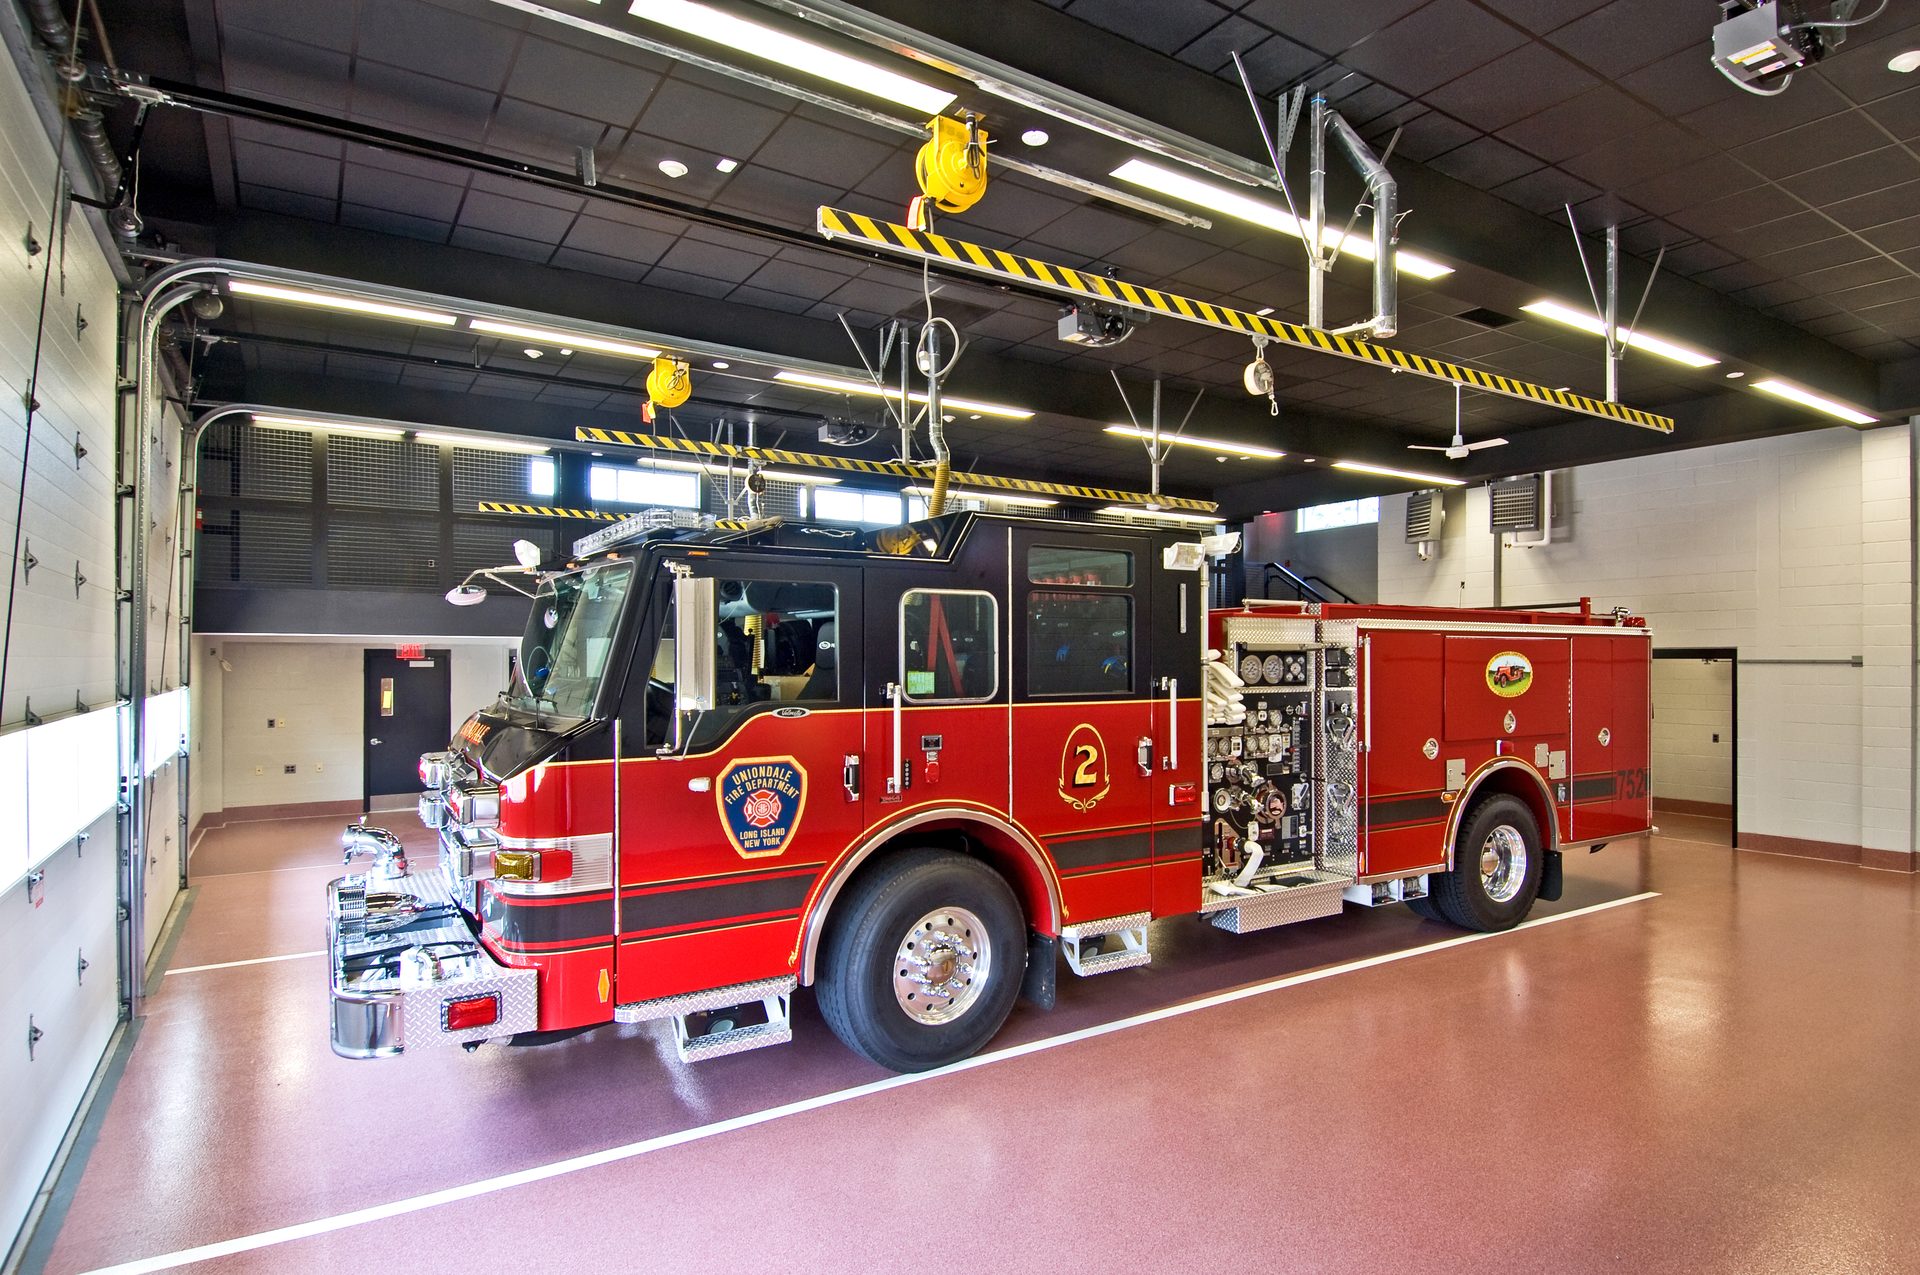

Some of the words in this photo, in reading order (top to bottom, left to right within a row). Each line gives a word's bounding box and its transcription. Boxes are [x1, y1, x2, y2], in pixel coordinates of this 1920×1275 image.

[732, 766, 793, 786] UNIONDALE
[1074, 745, 1098, 787] 2
[725, 786, 745, 805] FIRE
[746, 778, 800, 799] DEPARTMENT
[740, 830, 758, 840] LONG
[760, 827, 785, 838] ISLAND
[744, 839, 760, 849] NEW
[762, 837, 781, 846] YORK
